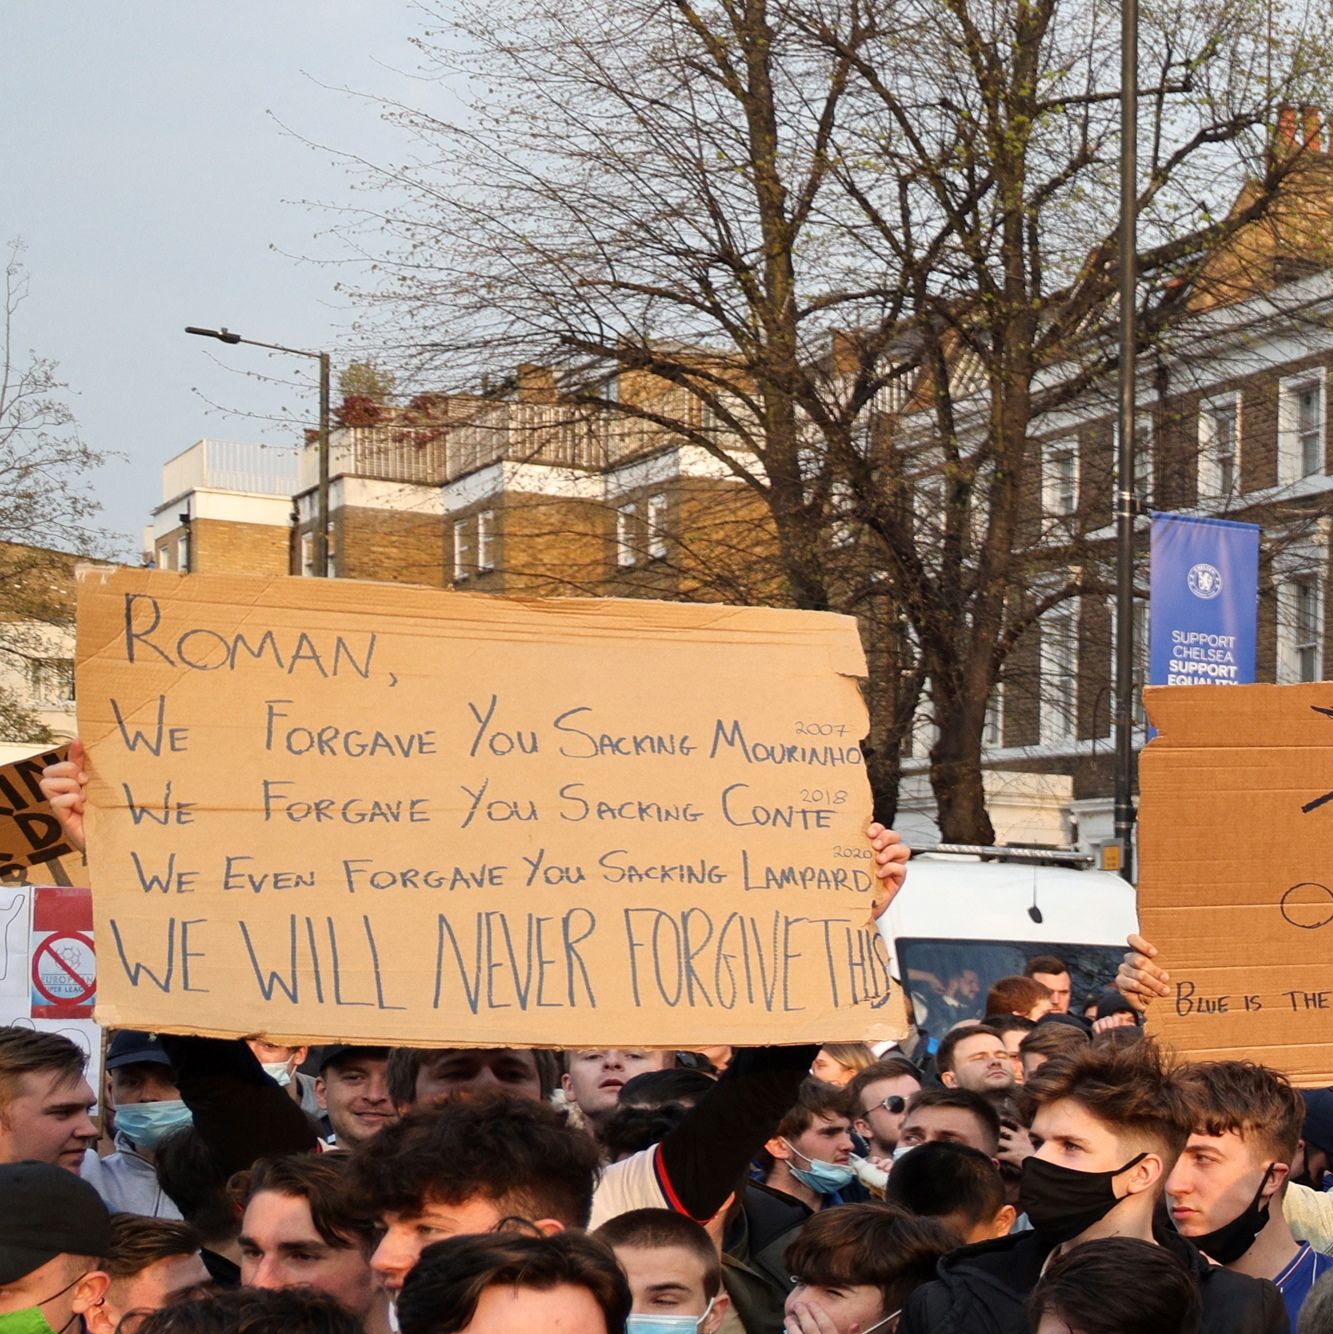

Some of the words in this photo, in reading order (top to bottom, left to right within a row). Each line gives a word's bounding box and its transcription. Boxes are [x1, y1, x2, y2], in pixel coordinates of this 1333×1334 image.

[125, 592, 398, 687] ROMAN,
[1171, 630, 1236, 649] SUPPORT
[1172, 645, 1235, 664] CHELSEA
[1168, 659, 1239, 678] SUPPORT
[552, 707, 697, 758] SACKING
[710, 719, 861, 766] MOURINHO
[795, 721, 850, 737] 2007
[559, 784, 704, 822] SACKING
[722, 784, 838, 830] CONTE
[800, 789, 848, 805] 2018
[833, 846, 873, 859] 2020
[224, 856, 315, 893] EVEN
[598, 850, 727, 883] SACKING
[742, 850, 873, 892] LAMPARD
[110, 917, 209, 993] WE
[238, 914, 406, 1010] WILL
[433, 908, 596, 1014] NEVER
[624, 908, 805, 1012] FORGIVE
[1176, 981, 1230, 1016] BLUE
[1244, 994, 1262, 1012] IS
[1282, 990, 1333, 1011] THE
